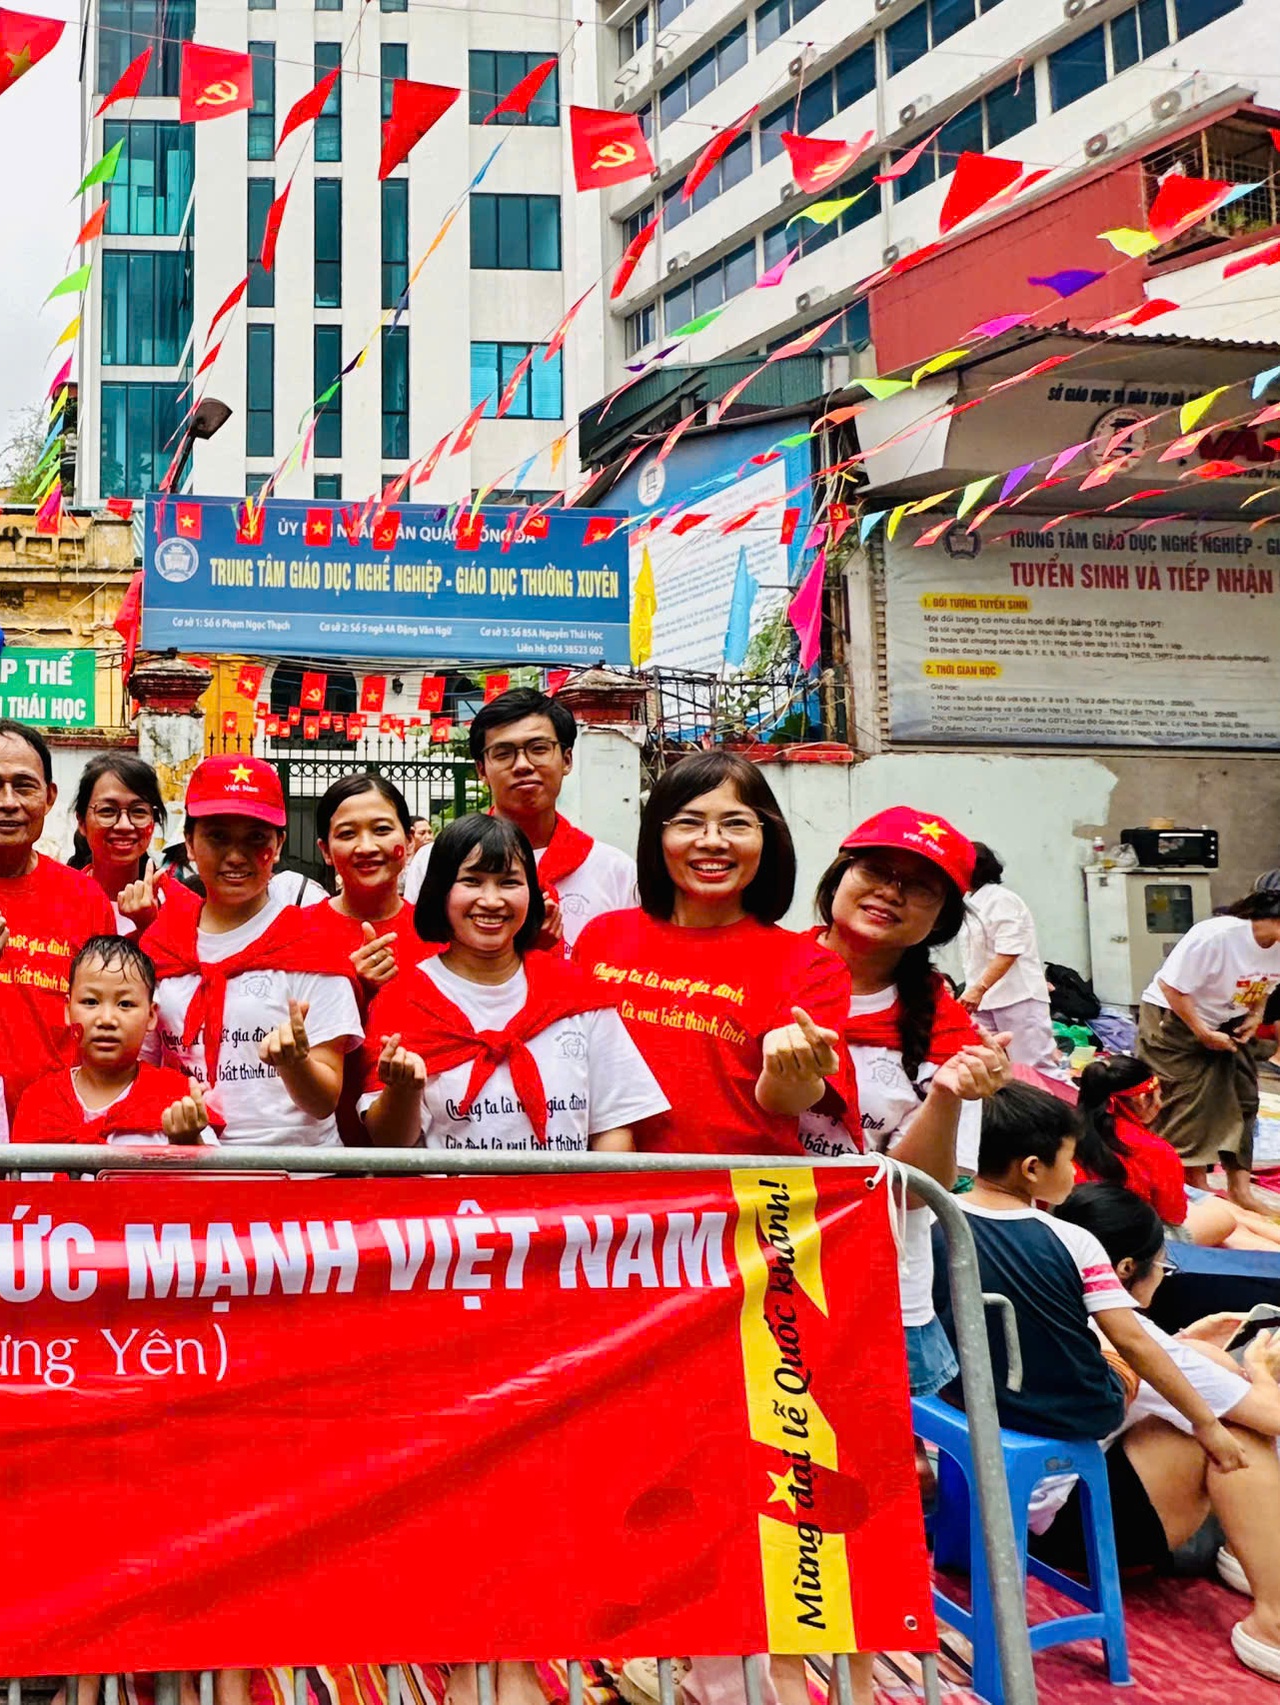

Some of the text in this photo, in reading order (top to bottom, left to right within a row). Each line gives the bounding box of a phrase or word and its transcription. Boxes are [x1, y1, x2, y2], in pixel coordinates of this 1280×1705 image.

[278, 517, 299, 536] ỦY
[1009, 528, 1253, 558] TRUNG TÂM GIÁO DỤC NGHỀ NGHIỆP
[210, 558, 254, 587] TRUNG
[257, 553, 286, 588] TÂM
[289, 557, 320, 590] GIÁO
[324, 562, 352, 596] DỤC
[355, 556, 391, 592] NGHỀ
[394, 559, 442, 600] NGHIỆP
[456, 560, 487, 595] GIÁO
[490, 567, 518, 601] DỤC
[521, 562, 573, 598] THƯỜNG
[577, 564, 619, 598] XUYÊN
[1010, 552, 1274, 599] TUYỂN SINH VÀ TIẾP NHẬN
[1008, 600, 1029, 610] SINH
[195, 618, 203, 628] 1:
[204, 617, 215, 628] Số
[215, 619, 221, 629] 6
[222, 619, 244, 631] Phạm
[245, 620, 266, 632] Ngọc
[267, 620, 291, 632] Thạch
[342, 623, 350, 633] 2:
[385, 624, 396, 634] 4A
[502, 627, 510, 637] 3:
[539, 626, 569, 640] Nguyễn
[569, 627, 587, 639] Thái
[588, 629, 604, 641] Học
[517, 643, 534, 653] Liên
[547, 644, 563, 654] 024
[564, 645, 588, 655] 38523
[589, 645, 604, 655] 602
[26, 651, 75, 685] THỂ
[926, 663, 997, 678] 2. THỜI GIAN HỌC
[7, 692, 46, 719] THÁI
[51, 697, 87, 725] HỌC
[628, 968, 643, 984] ta
[644, 971, 660, 988] là
[660, 978, 691, 994] một
[686, 979, 710, 998] gia
[712, 984, 745, 1007] đình
[637, 1008, 659, 1024] vui
[661, 1005, 685, 1029] bất
[685, 1010, 719, 1037] thình
[232, 1028, 250, 1048] gia
[484, 1097, 514, 1115] ta là
[547, 1097, 567, 1119] gia
[124, 1219, 359, 1313] MẠNH
[378, 1199, 540, 1310] VIỆT
[558, 1211, 732, 1290] NAM
[100, 1322, 228, 1382] Yên)
[763, 1304, 812, 1395] Quốc
[772, 1400, 809, 1439] lễ
[782, 1449, 820, 1510] đại
[793, 1522, 826, 1630] Mừng
